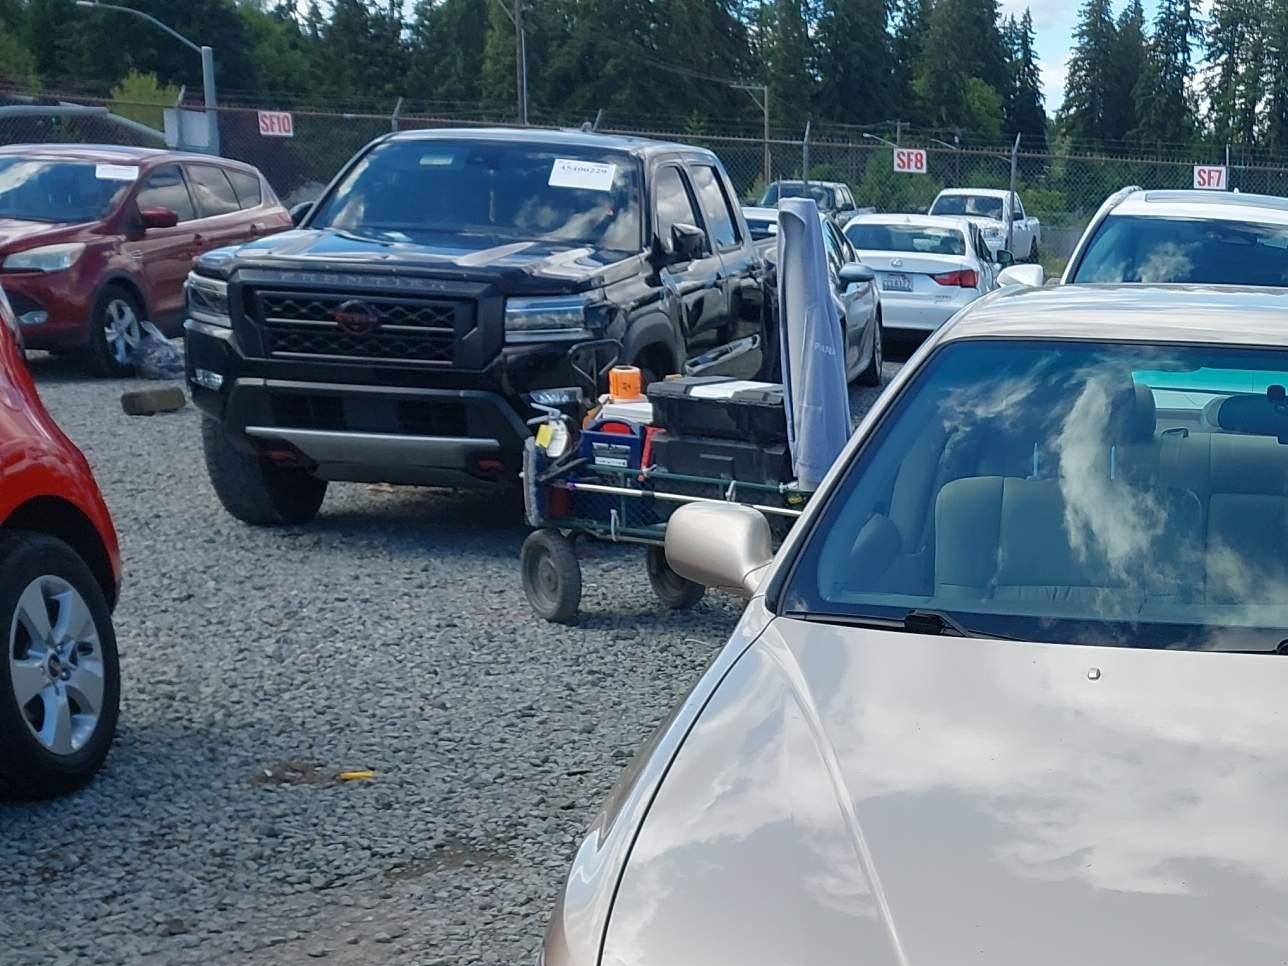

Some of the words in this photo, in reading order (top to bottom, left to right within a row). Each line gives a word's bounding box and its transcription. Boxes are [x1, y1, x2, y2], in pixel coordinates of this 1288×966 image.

[260, 113, 290, 134] SF10
[896, 151, 924, 170] SF8
[1197, 168, 1223, 187] SF7
